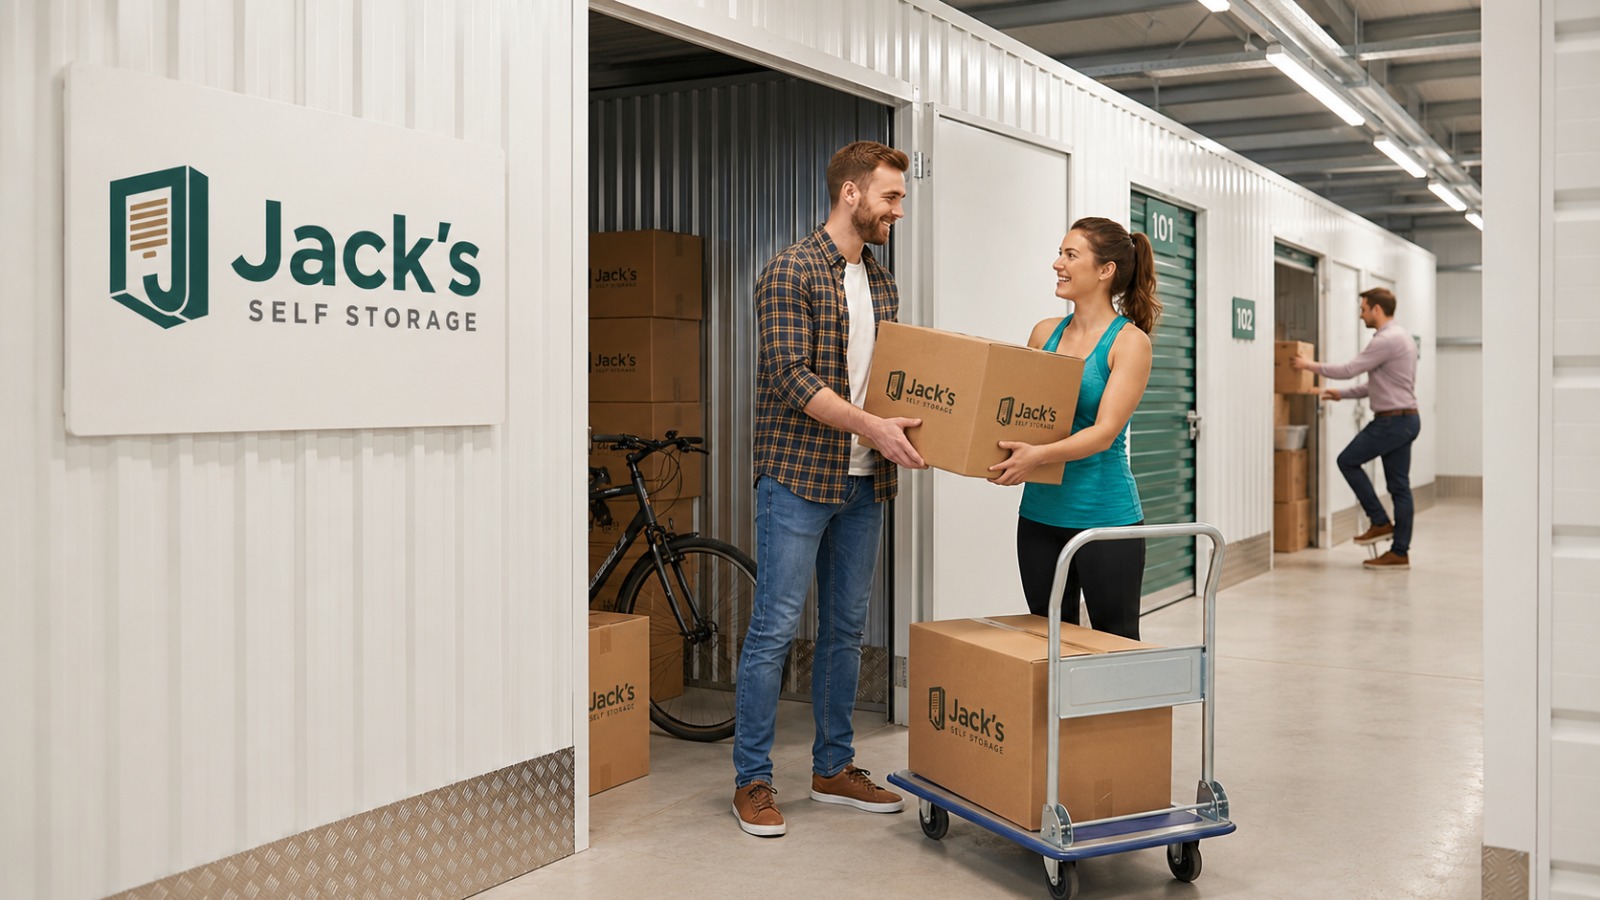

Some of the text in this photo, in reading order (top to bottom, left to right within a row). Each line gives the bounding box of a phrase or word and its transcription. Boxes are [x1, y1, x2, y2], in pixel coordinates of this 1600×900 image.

[1152, 212, 1174, 243] 101
[231, 199, 481, 297] Jack's
[594, 267, 637, 282] Jack's
[248, 299, 477, 332] SELF STORAGE
[1236, 307, 1253, 331] 102
[594, 353, 637, 367] Jack's
[906, 379, 957, 407] Jack's
[1015, 402, 1058, 423] Jack's
[589, 683, 635, 712] Jack's
[948, 698, 1005, 743] Jack's
[950, 725, 967, 737] SELF
